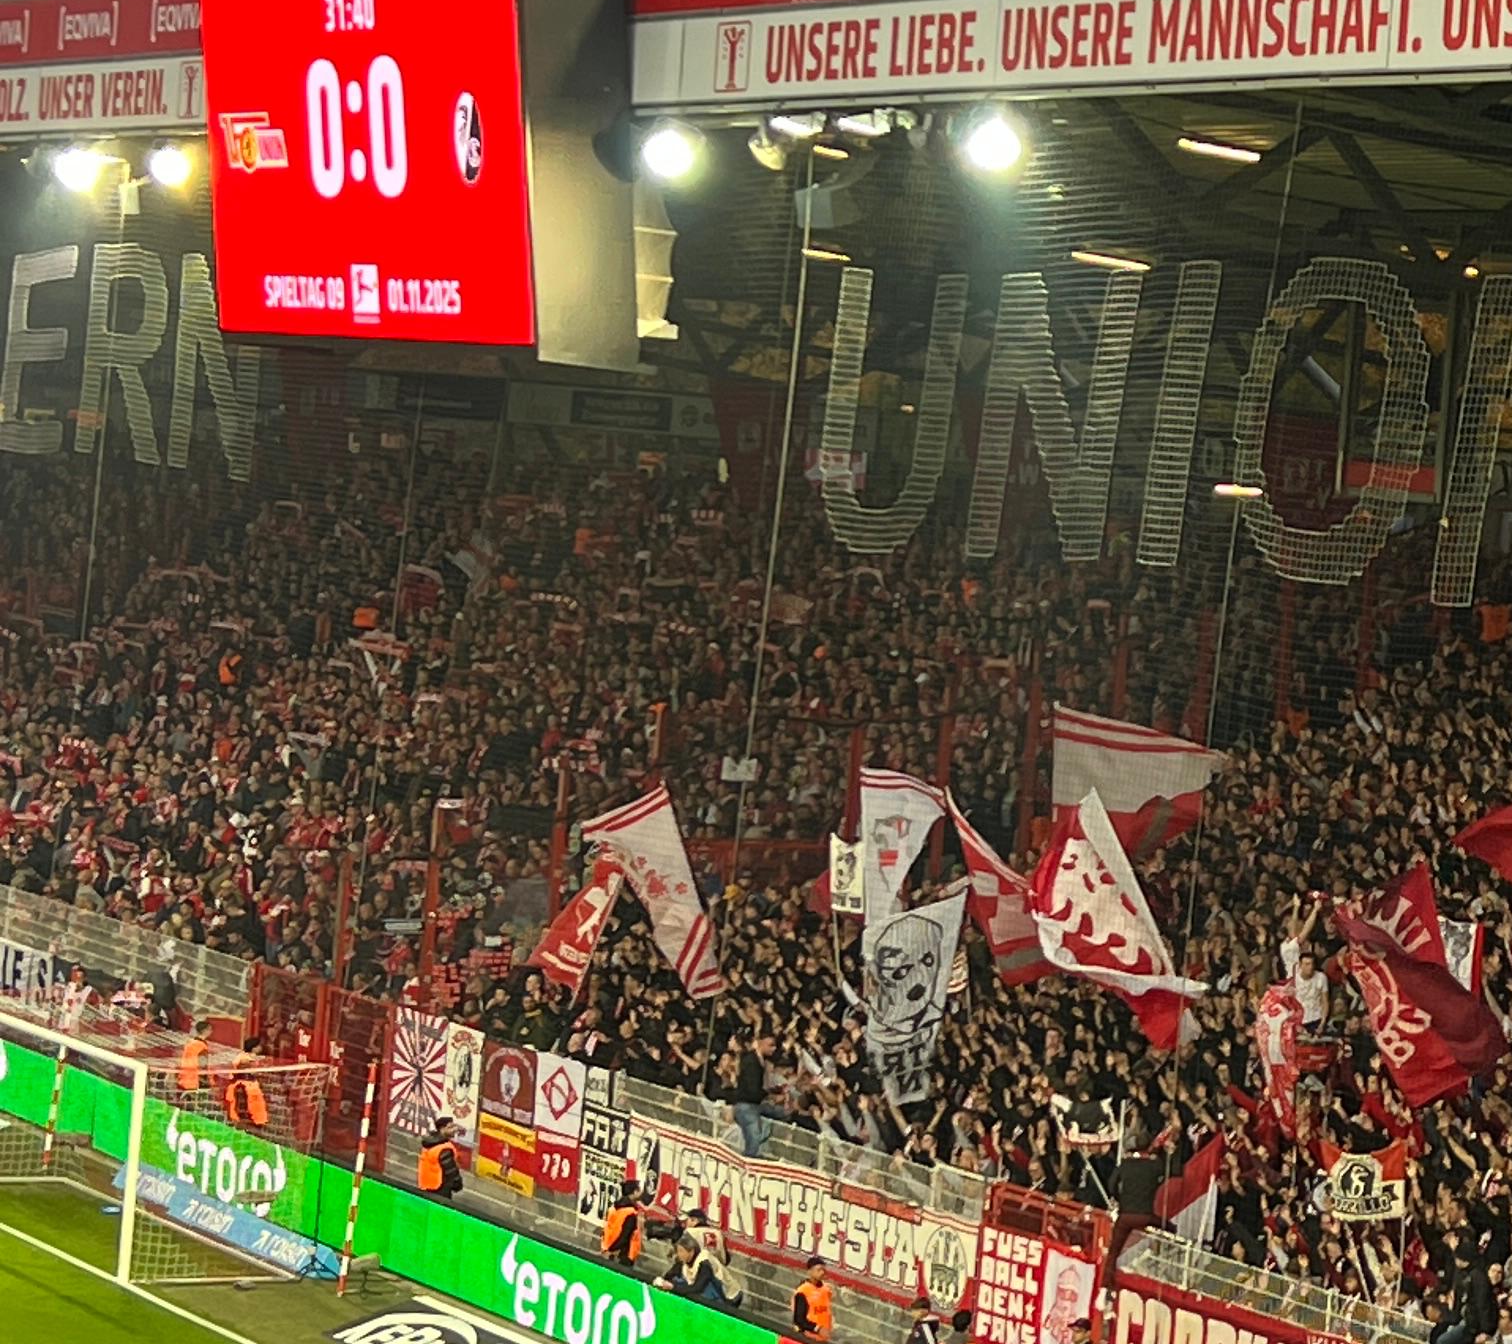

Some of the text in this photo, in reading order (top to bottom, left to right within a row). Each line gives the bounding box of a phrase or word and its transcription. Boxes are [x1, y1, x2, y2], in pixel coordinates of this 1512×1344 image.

[765, 18, 881, 83] UNSERE
[889, 11, 985, 77] LIEBE.
[1001, 0, 1136, 72] UNSERE
[38, 73, 95, 121] UNSER
[101, 68, 168, 118] VEREIN.
[305, 54, 408, 199] 0:0
[263, 275, 462, 315] SPIELTAG 09 01.11.2025
[678, 1148, 920, 1289] SYNTHESIA
[983, 1225, 1044, 1267] FUSS
[980, 1256, 1041, 1293] BALL
[978, 1286, 1025, 1322] DEN
